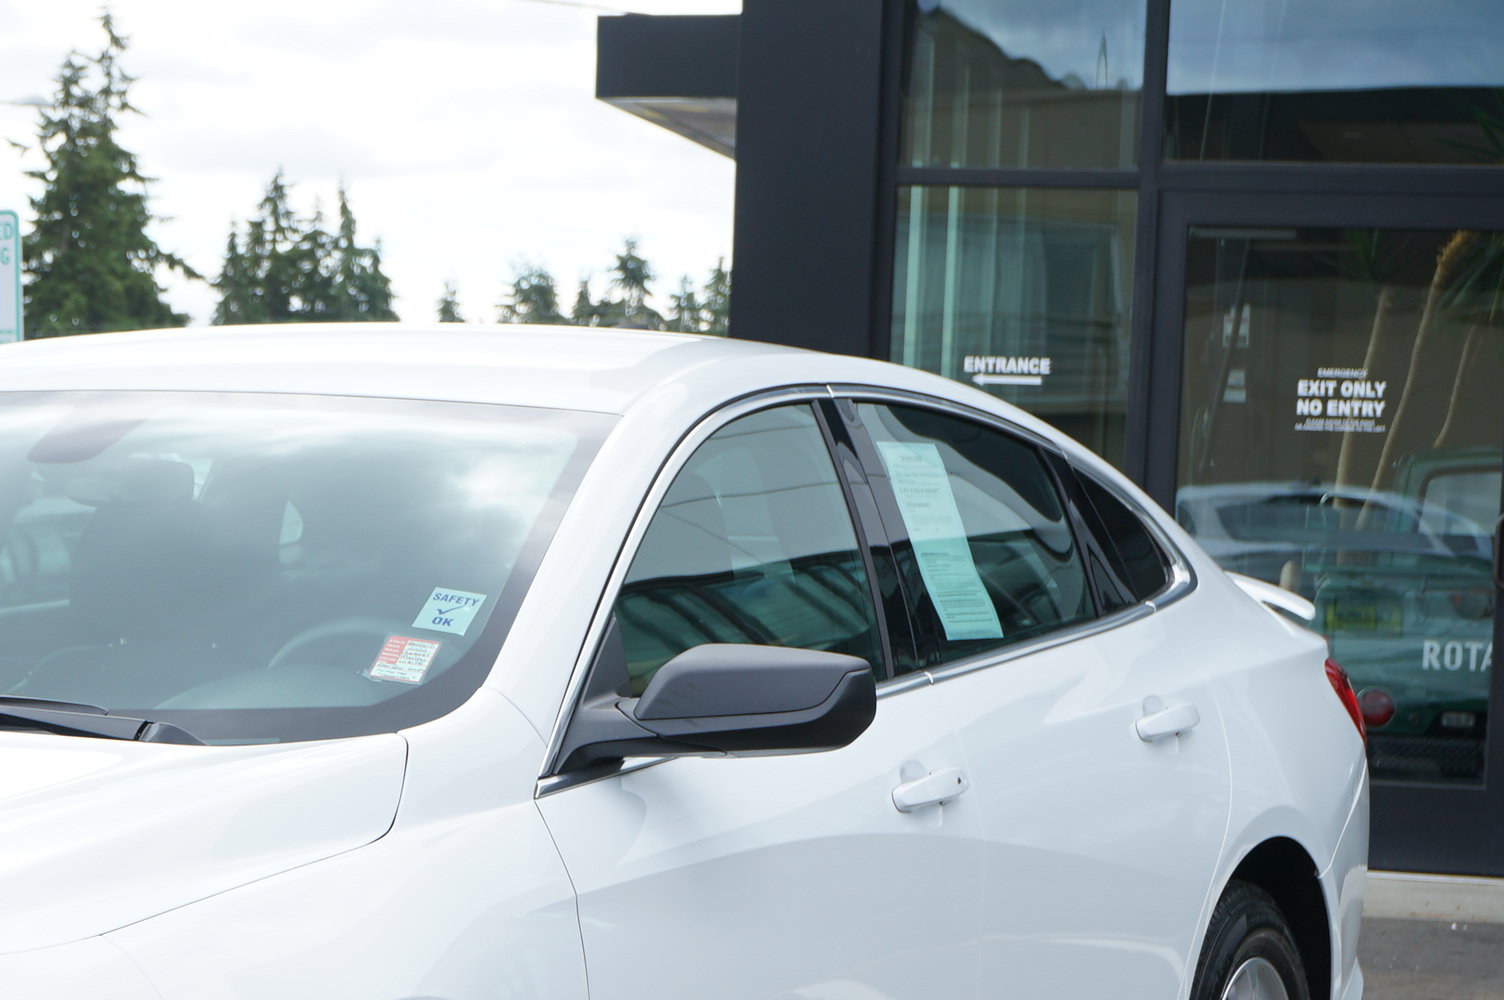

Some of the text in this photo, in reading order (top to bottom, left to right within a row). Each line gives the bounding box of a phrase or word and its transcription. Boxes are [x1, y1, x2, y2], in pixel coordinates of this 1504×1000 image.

[963, 355, 1052, 375] ENTRANCE
[1297, 379, 1387, 399] EXIT ONLY
[1296, 398, 1386, 418] NO ENTRY
[432, 592, 480, 607] SAFETY
[431, 616, 455, 628] OK
